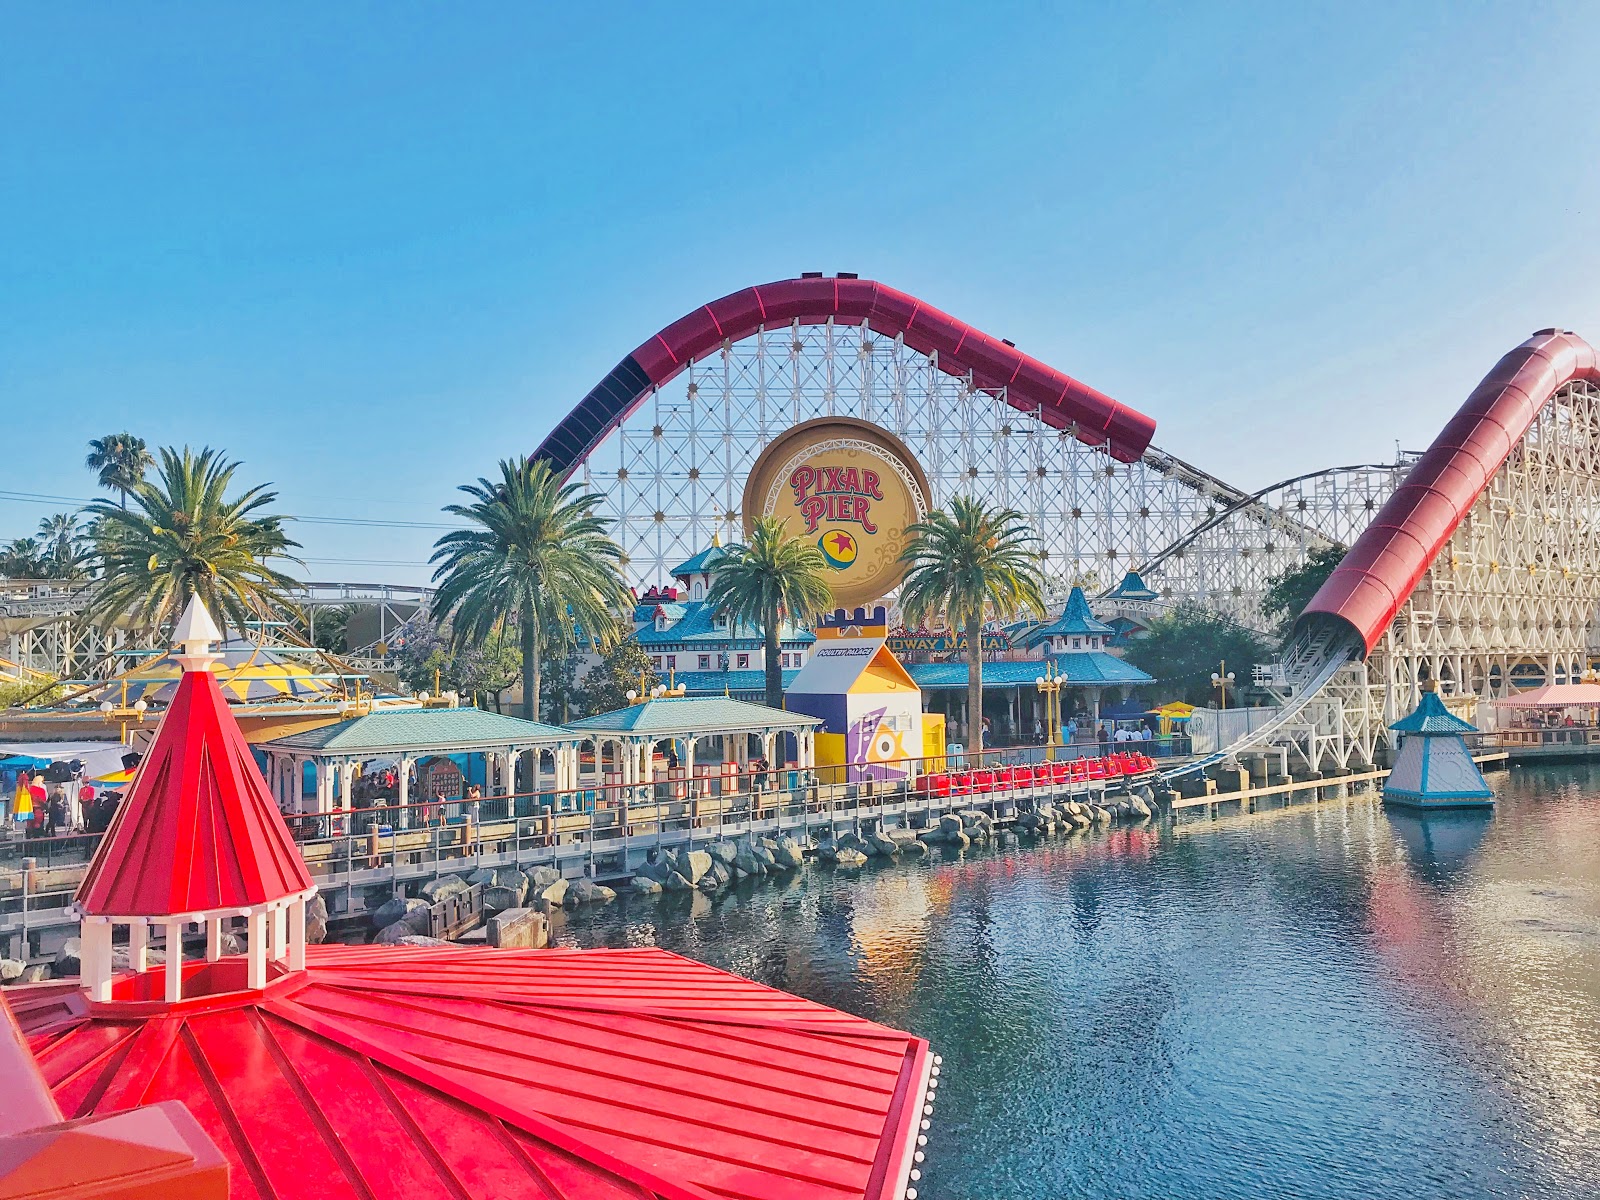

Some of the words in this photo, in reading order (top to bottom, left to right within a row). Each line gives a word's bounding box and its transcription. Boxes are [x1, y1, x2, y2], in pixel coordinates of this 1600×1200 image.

[790, 465, 884, 506] PIXAR
[801, 495, 878, 534] PIER
[817, 648, 847, 657] POULTRY
[846, 647, 873, 656] PALACE
[887, 639, 939, 650] IDWAY
[943, 638, 1004, 649] MAIA!
